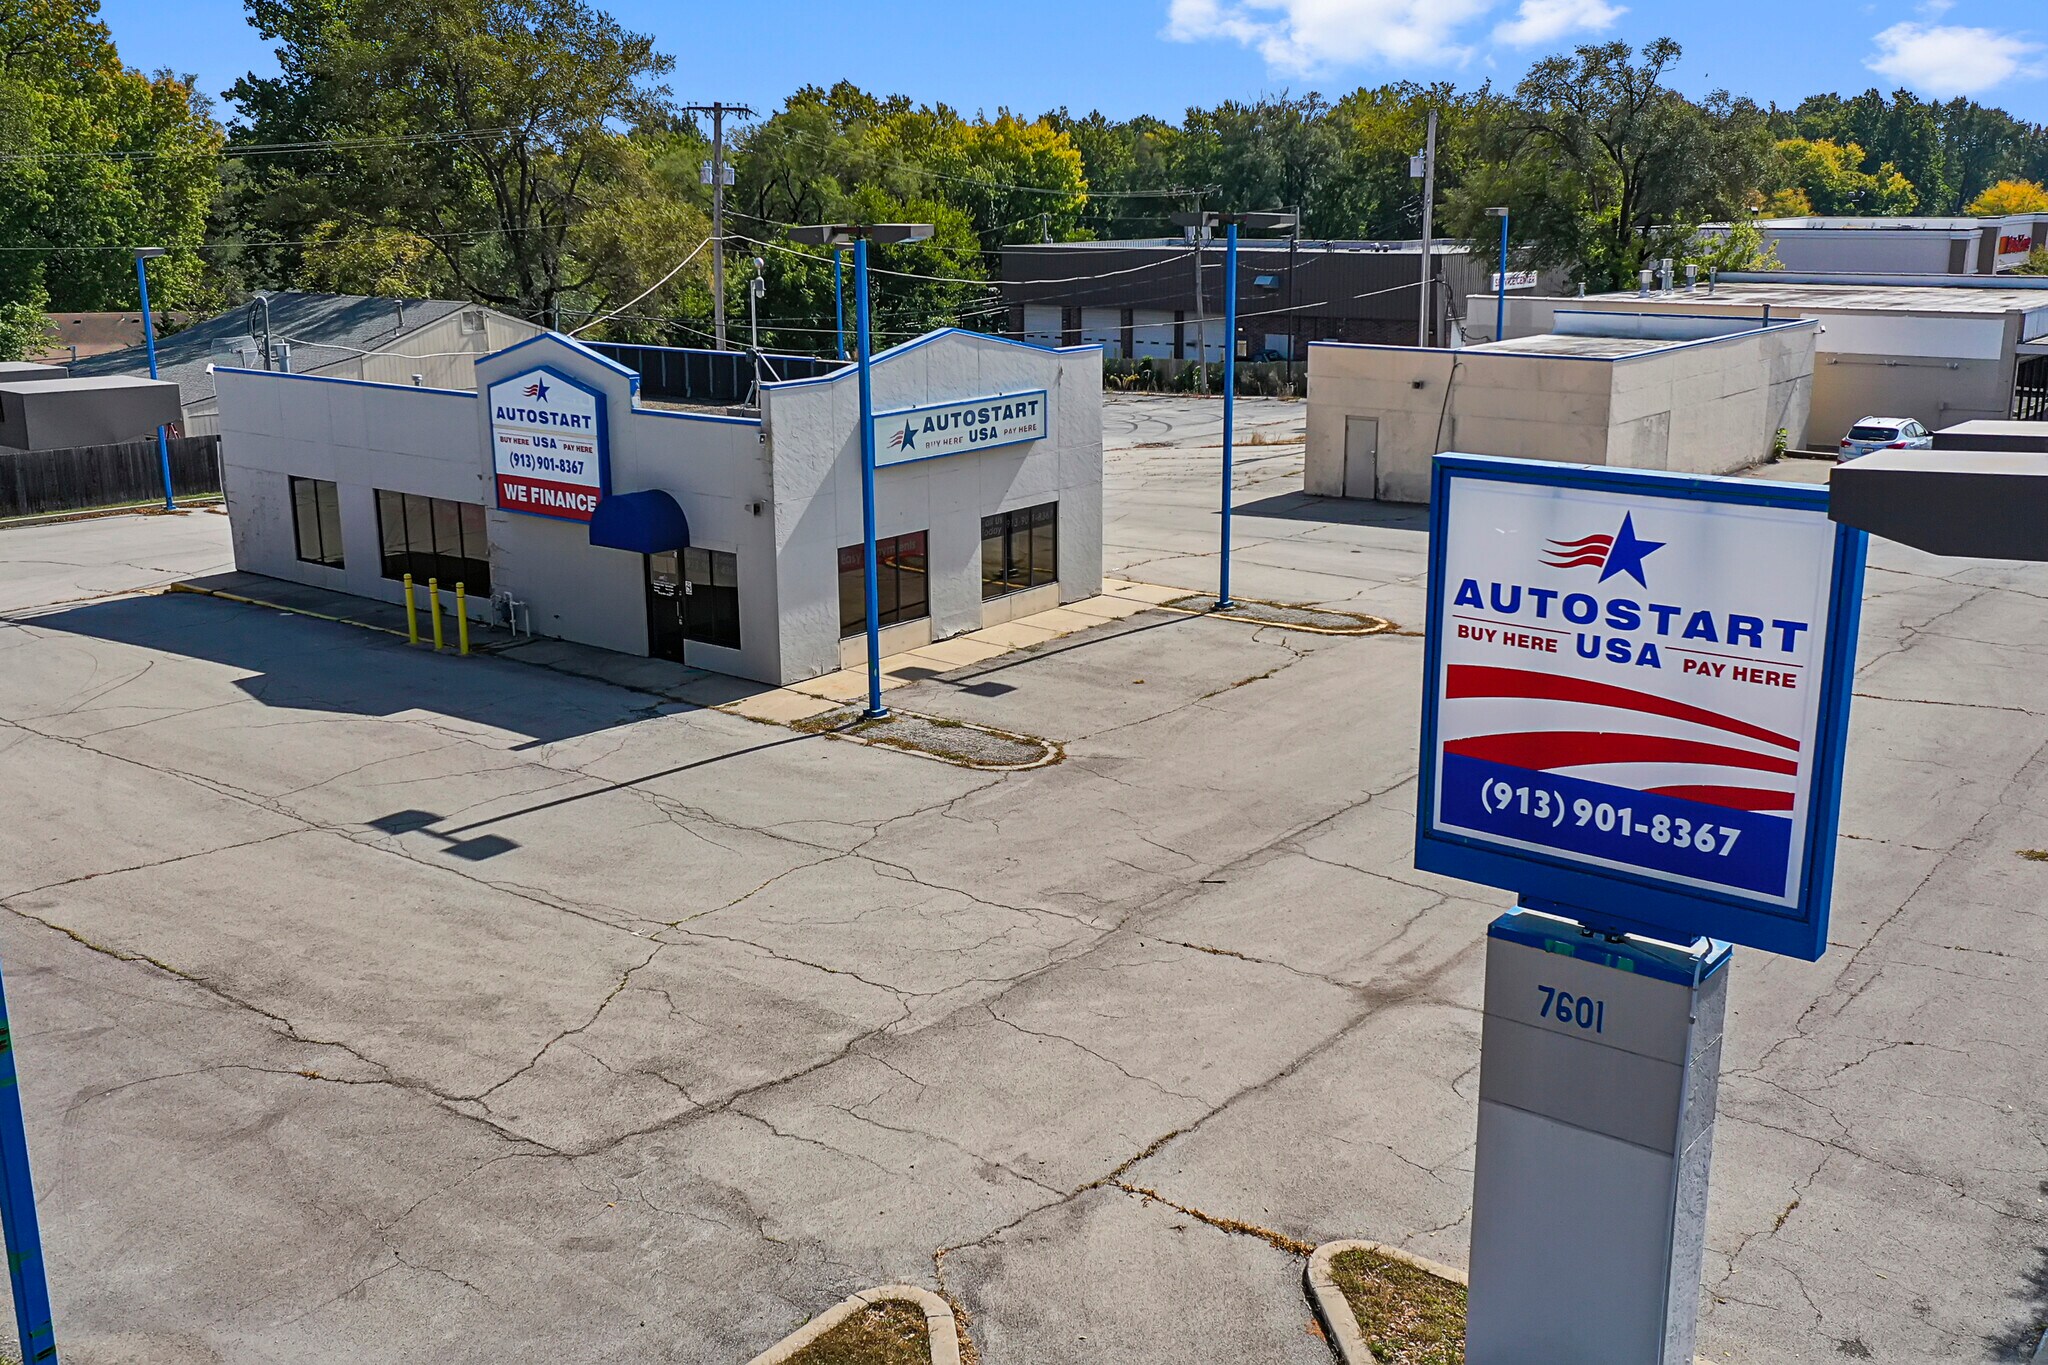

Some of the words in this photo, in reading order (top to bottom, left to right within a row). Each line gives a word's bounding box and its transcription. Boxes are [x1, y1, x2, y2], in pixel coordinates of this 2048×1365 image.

[496, 406, 591, 428] AUTOSTART
[922, 400, 1038, 433] AUTOSTART
[1004, 427, 1017, 435] PAY
[1018, 424, 1037, 432] HERE
[514, 438, 529, 446] HERE
[533, 436, 557, 449] USA
[969, 427, 998, 442] USA
[510, 452, 535, 471] (913)
[538, 456, 584, 475] 901-8367
[576, 446, 593, 454] HERE
[504, 483, 528, 502] WE
[530, 486, 597, 512] FINANCE
[1454, 578, 1808, 653] AUTOSTART
[1458, 624, 1496, 643] BUY
[1503, 632, 1558, 653] HERE
[1576, 633, 1662, 668] USA
[1683, 658, 1726, 678] PAY
[1733, 666, 1797, 689] HERE
[1482, 778, 1564, 828] (913)
[1573, 798, 1742, 857] 901-8367
[1538, 985, 1604, 1034] 7601
